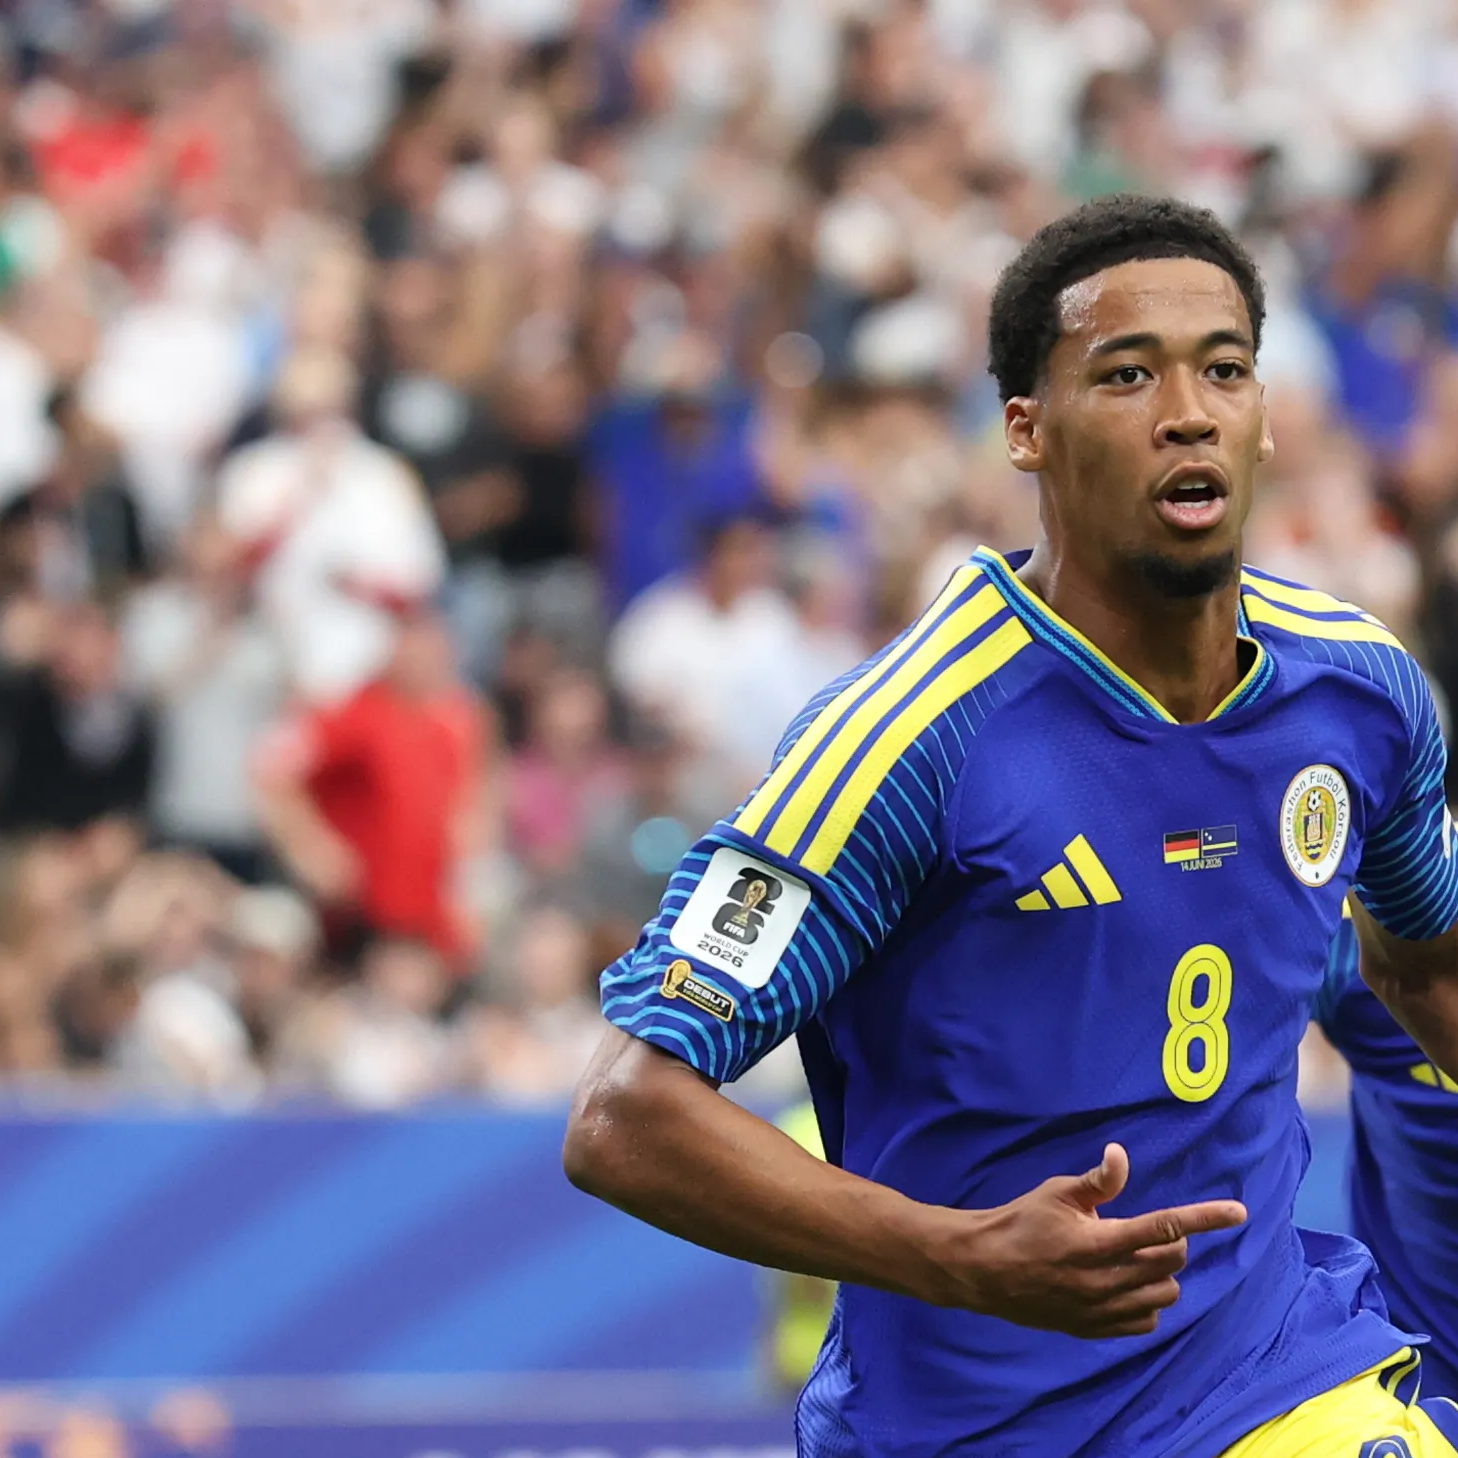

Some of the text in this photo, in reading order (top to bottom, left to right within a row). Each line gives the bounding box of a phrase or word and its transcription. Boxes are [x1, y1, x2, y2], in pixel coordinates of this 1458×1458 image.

[722, 921, 747, 938] FIFA
[696, 939, 745, 968] 2026
[703, 932, 749, 957] WORLD CUP
[683, 979, 730, 1008] DEBUT
[1161, 943, 1234, 1103] 8
